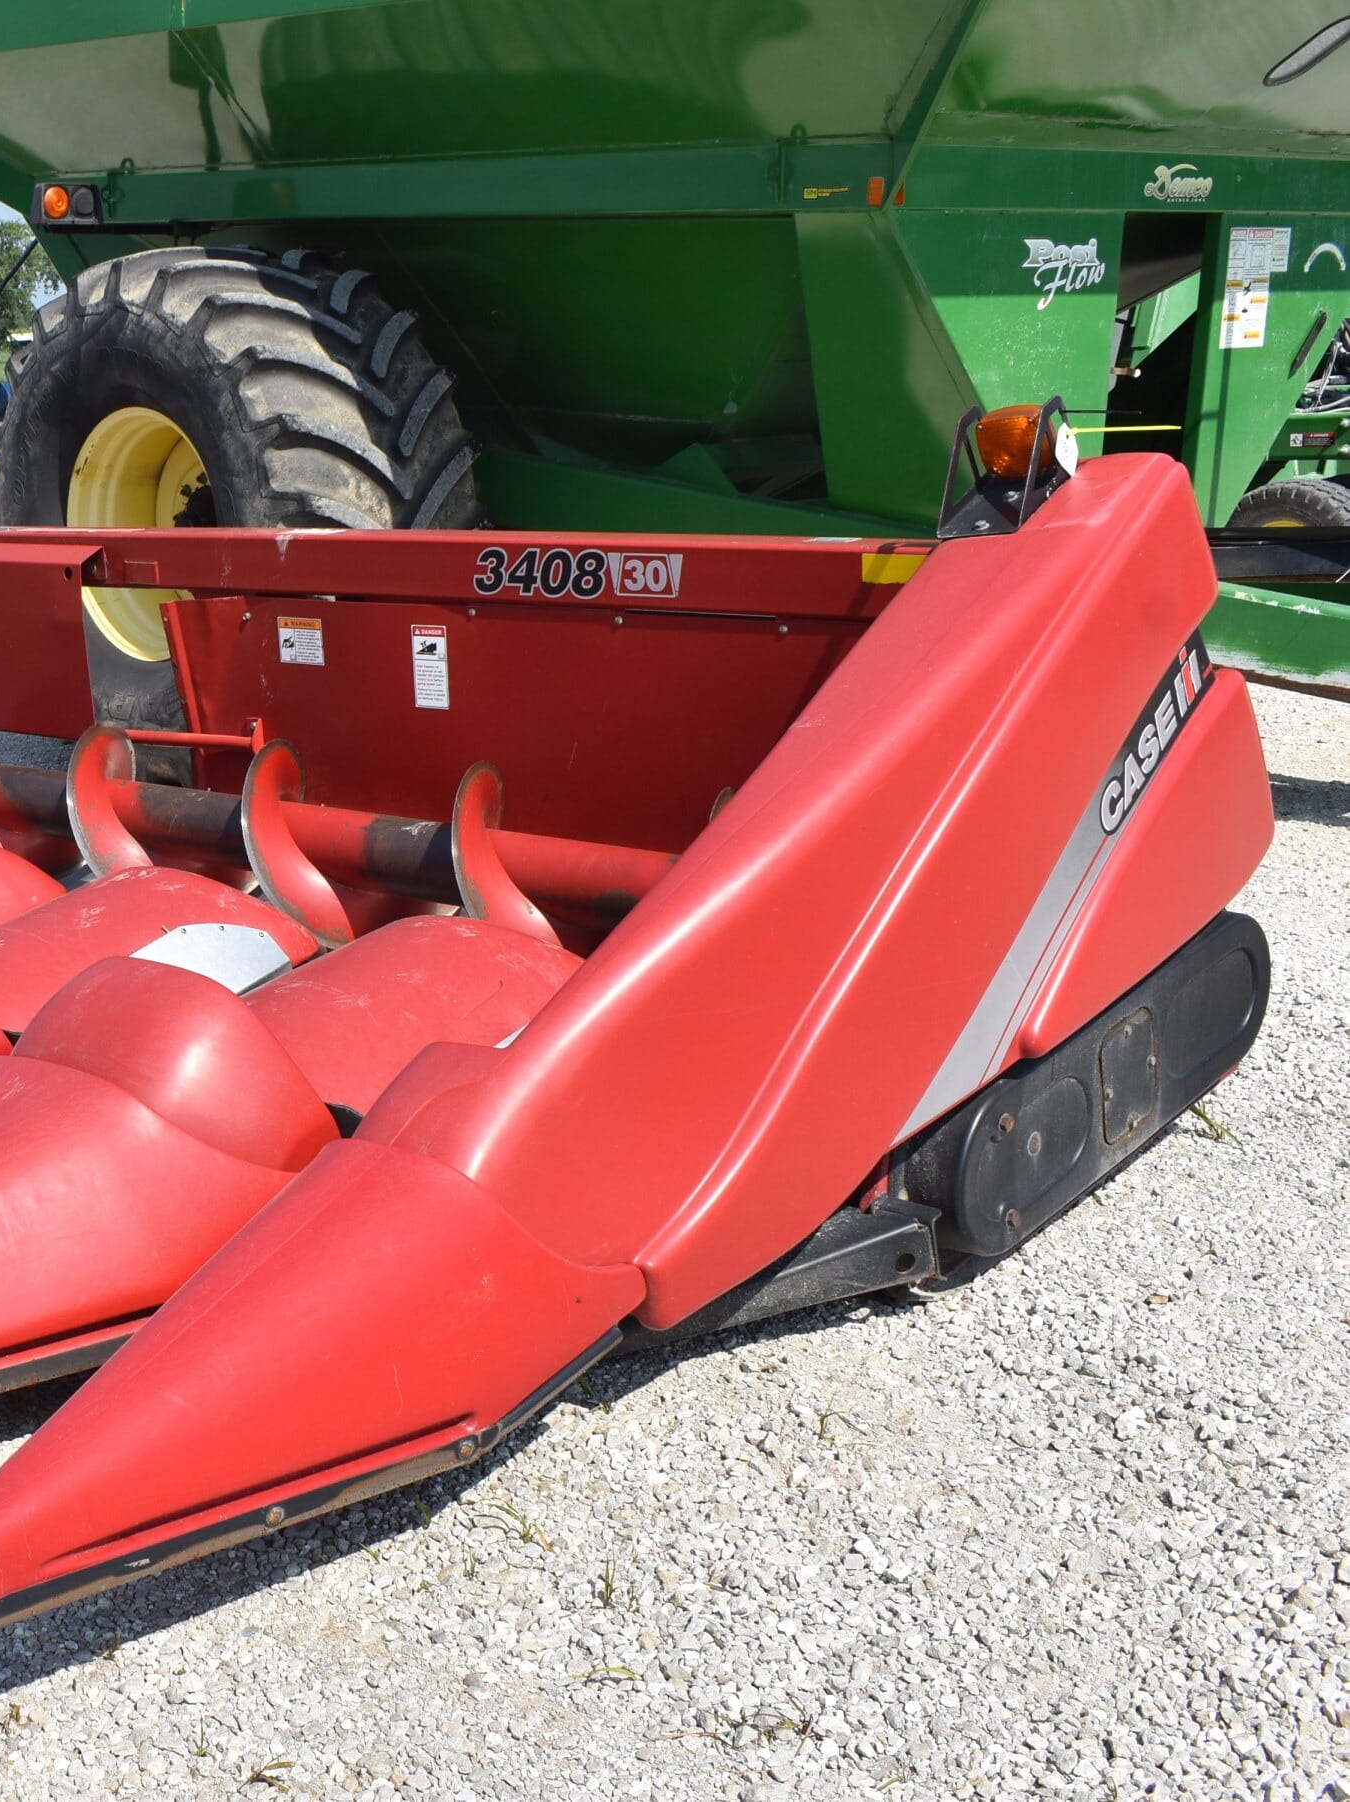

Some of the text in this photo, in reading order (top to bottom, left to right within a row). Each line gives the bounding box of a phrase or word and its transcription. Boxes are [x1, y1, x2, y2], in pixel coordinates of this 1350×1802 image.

[1022, 238, 1100, 267] Posi
[1034, 259, 1105, 311] Flow
[473, 546, 668, 600] 3408 30
